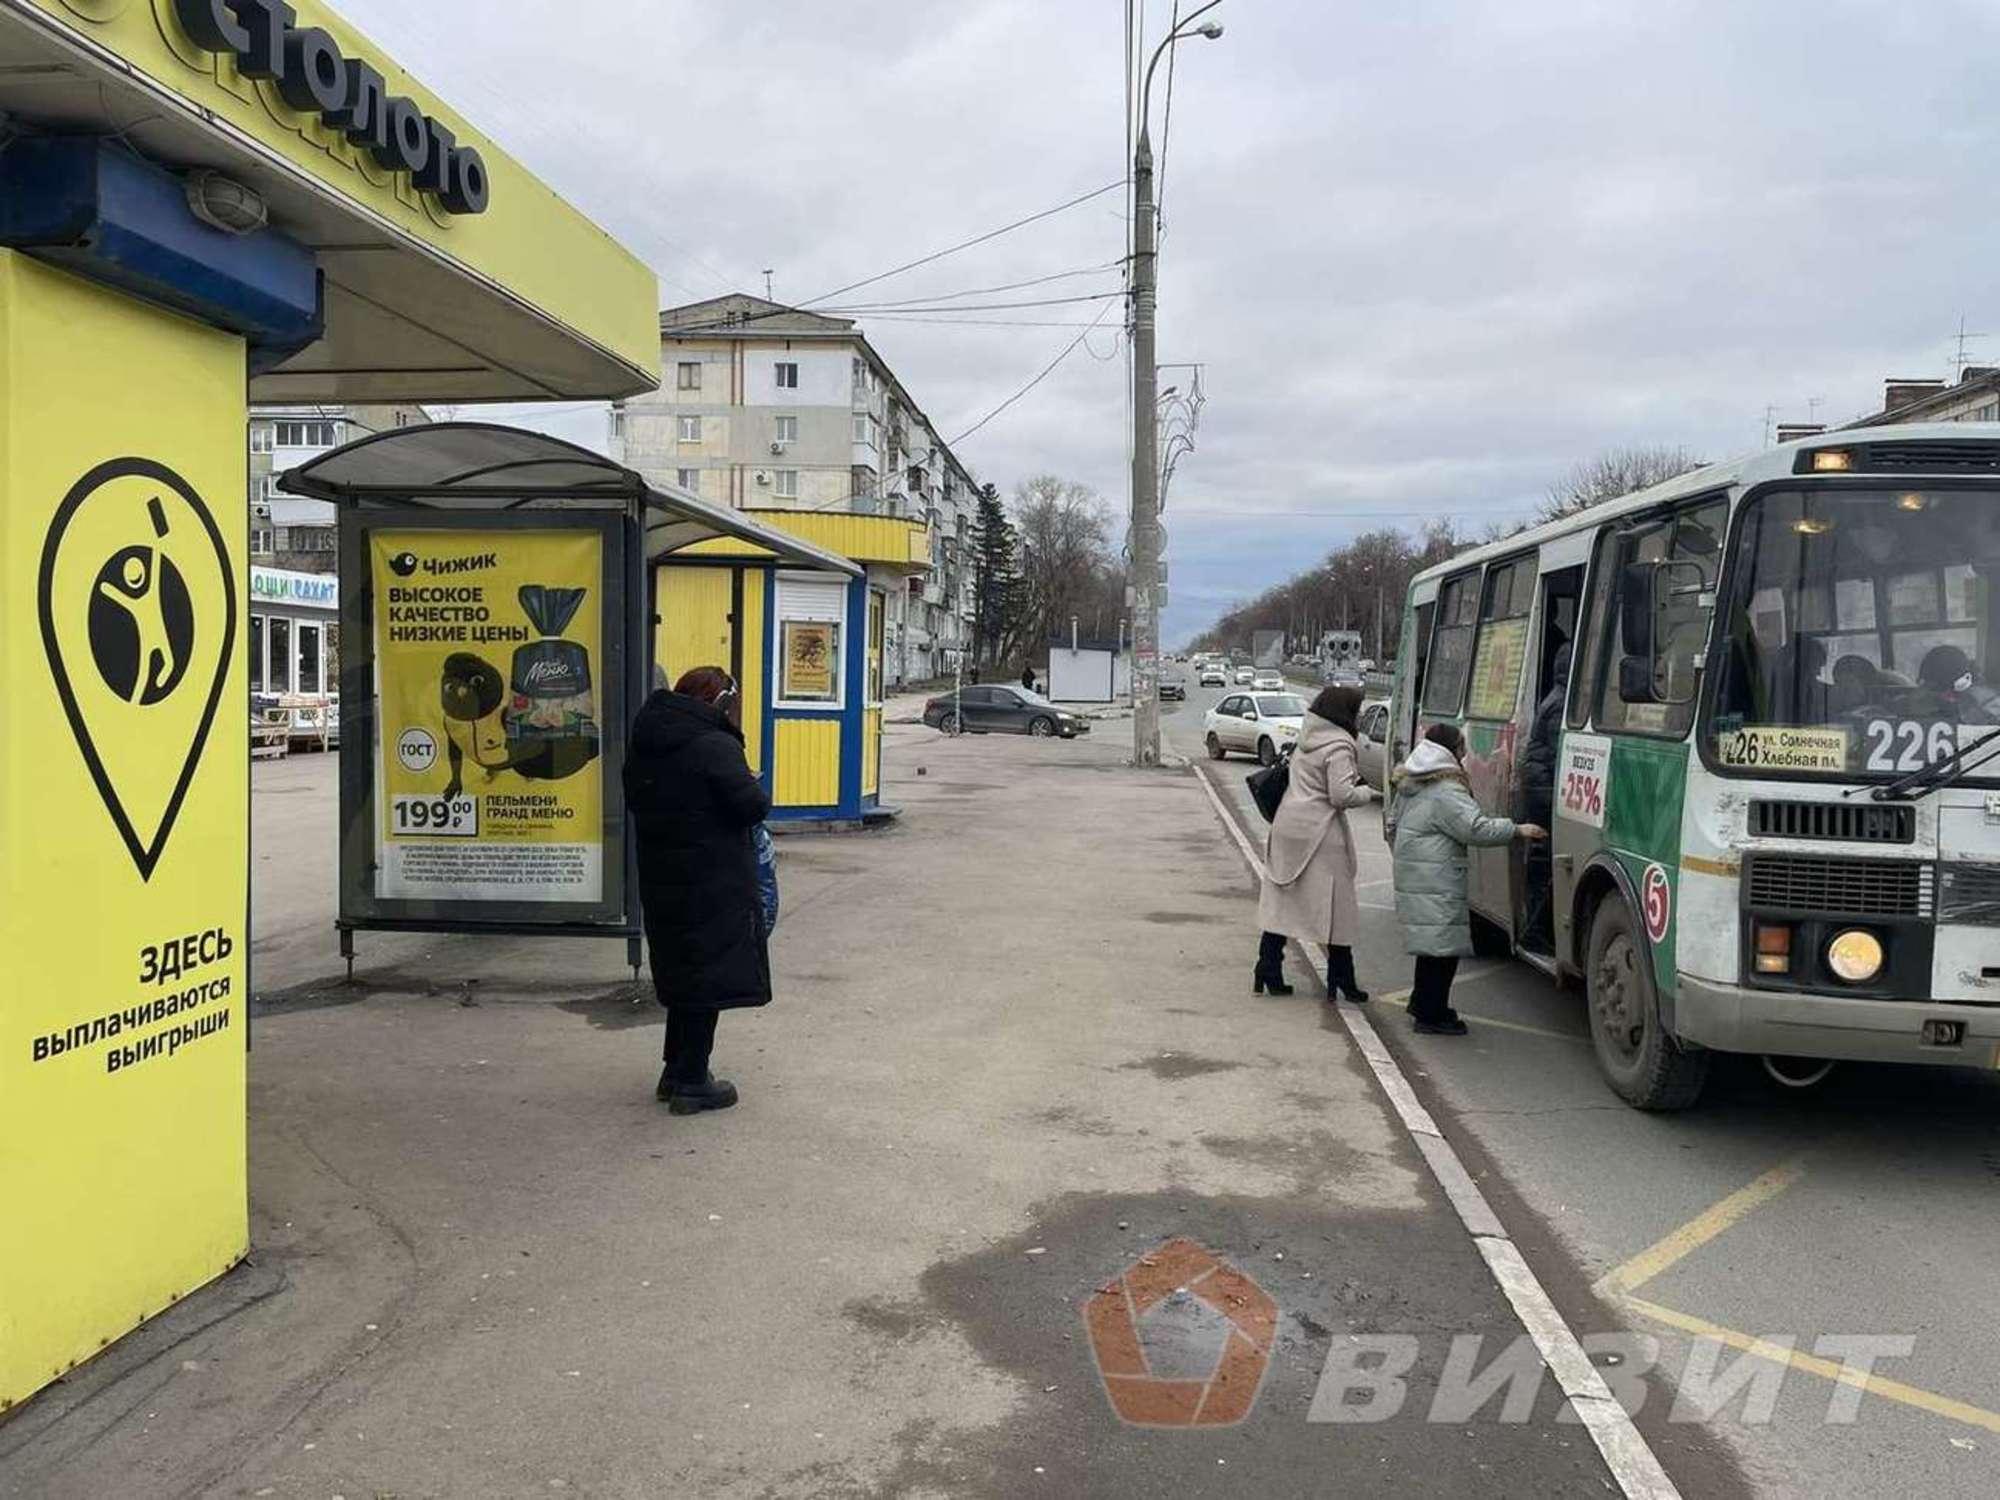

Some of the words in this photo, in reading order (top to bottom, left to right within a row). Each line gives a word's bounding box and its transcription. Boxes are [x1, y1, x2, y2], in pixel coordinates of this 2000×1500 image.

[389, 588, 483, 602] ВЫСОКОЕ
[389, 607, 490, 622] КАЧЕСТВО
[389, 626, 467, 641] НИЗКИЕ
[471, 626, 529, 644] ЦЕНЫ
[1780, 733, 1841, 748] Солнечная
[1867, 720, 1955, 772] 226
[401, 744, 432, 756] ГОСТ
[1761, 750, 1818, 766] Хлебная
[1821, 757, 1841, 768] пл.
[486, 795, 557, 806] ПЕЛЬМЕНИ
[394, 801, 450, 828] 199
[486, 808, 528, 819] ГРАНД
[531, 807, 574, 819] МЕНЮ
[140, 928, 232, 986] ЗДЕСЬ
[32, 976, 231, 1062] выплачиваются
[107, 1008, 229, 1073] выигрыши
